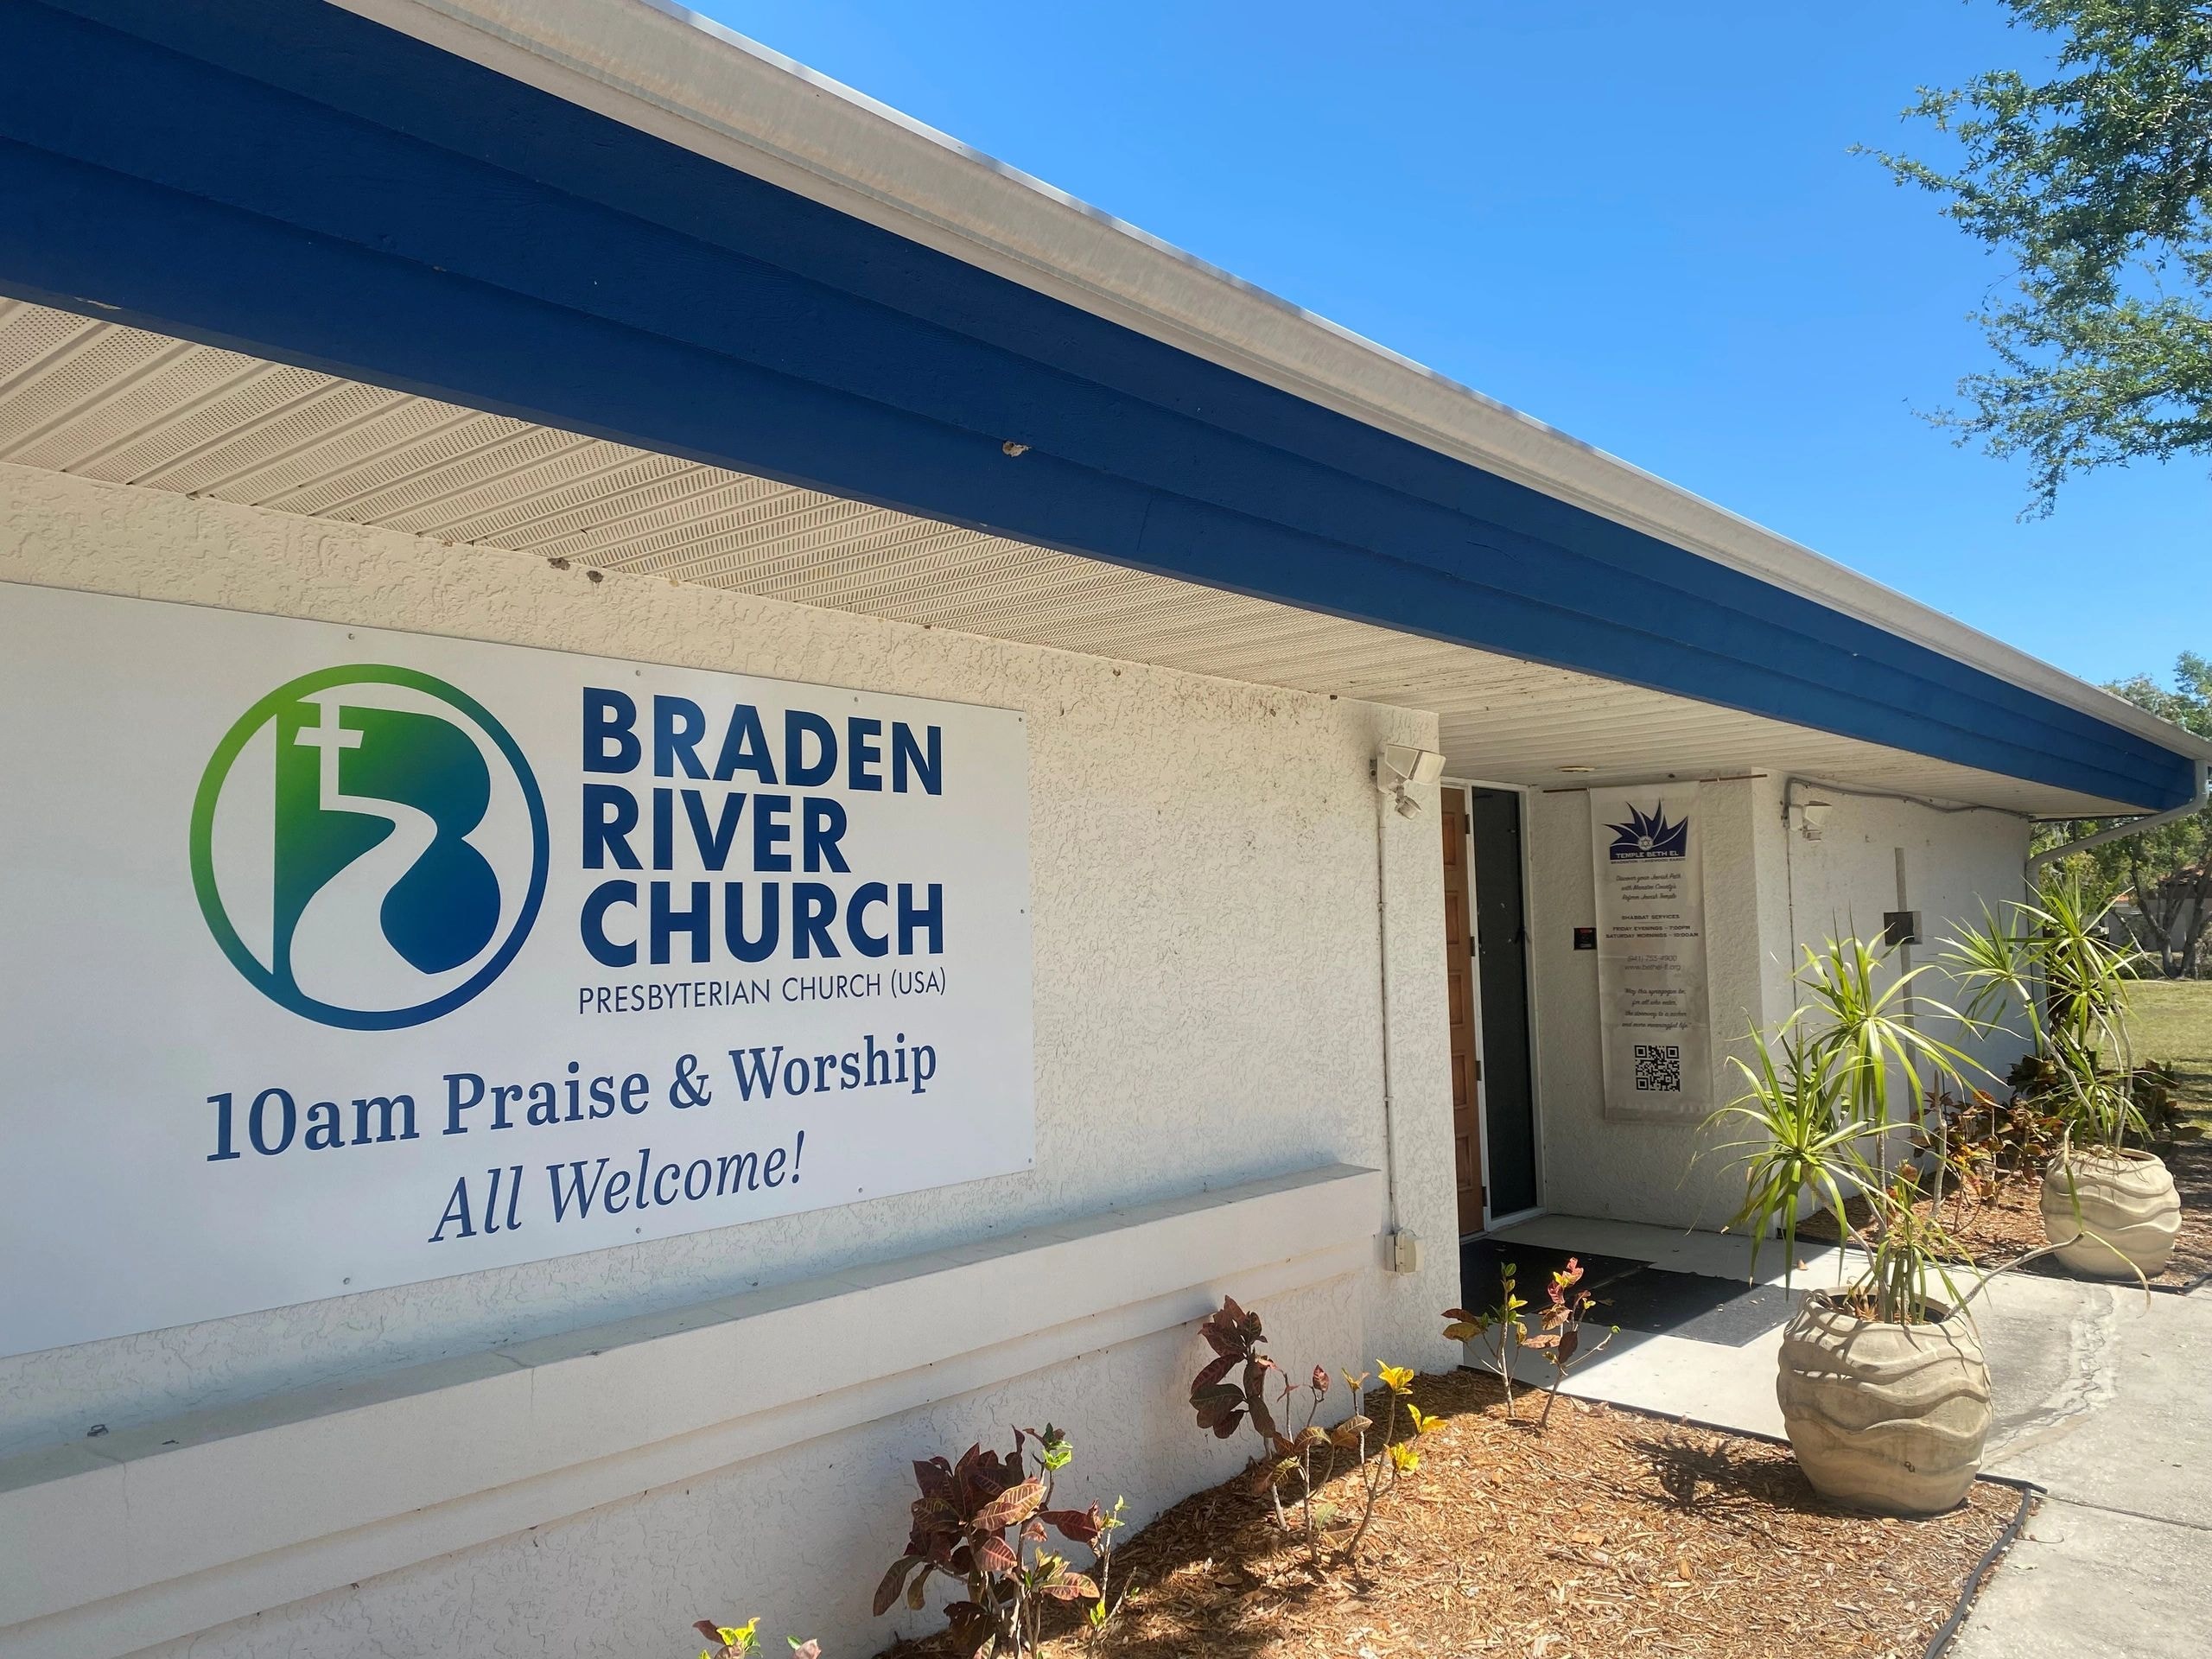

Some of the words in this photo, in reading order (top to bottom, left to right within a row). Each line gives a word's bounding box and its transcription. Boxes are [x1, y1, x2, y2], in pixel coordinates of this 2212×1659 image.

[583, 687, 942, 796] BRADEN
[582, 783, 852, 873] RIVER
[580, 879, 944, 968] CHURCH
[580, 978, 770, 1014] PRESBYTERIAN
[782, 973, 880, 1002] CHURCH
[891, 967, 945, 1000] (USA)
[207, 1088, 420, 1162] 10am
[442, 1061, 650, 1135] Praise
[669, 1053, 712, 1109] &
[728, 1033, 937, 1102] Worship
[428, 1165, 524, 1243] All
[545, 1129, 804, 1224] Welcome!
